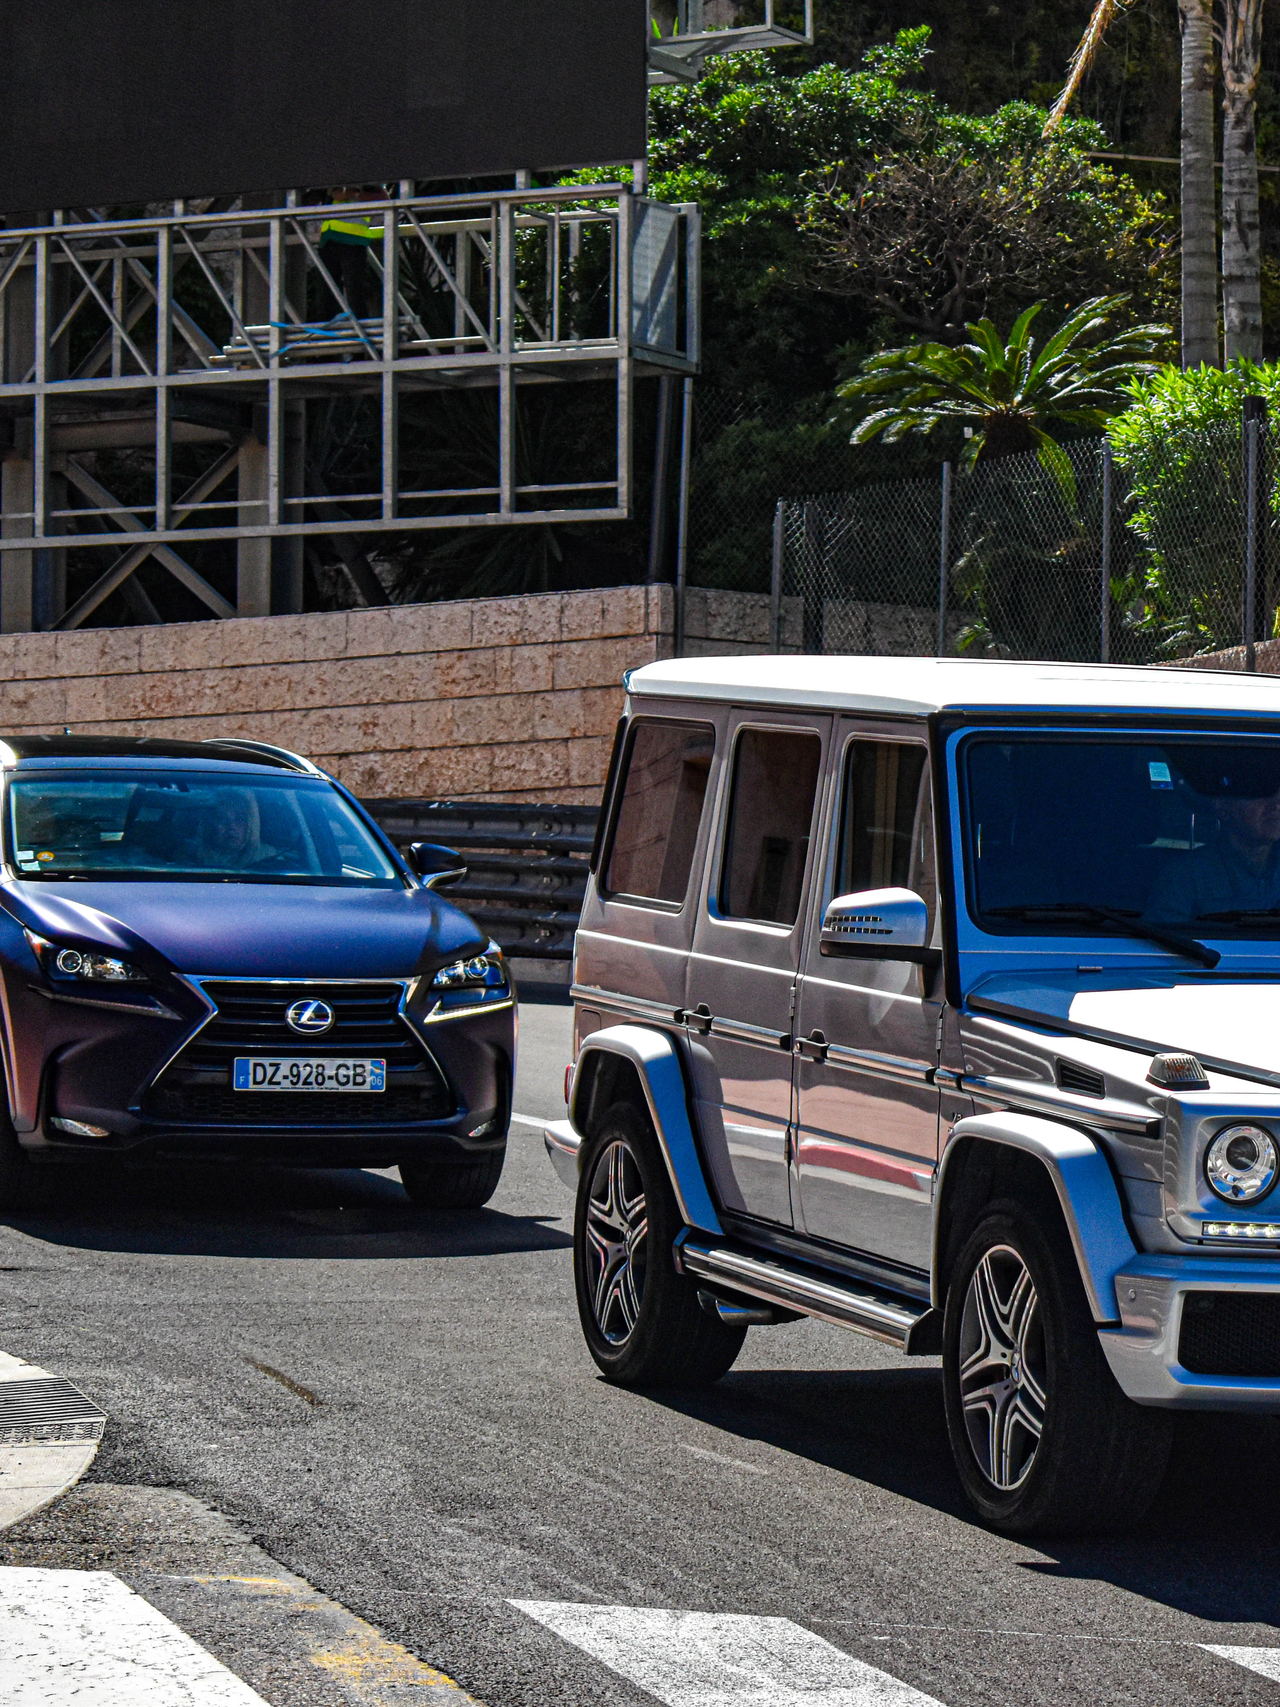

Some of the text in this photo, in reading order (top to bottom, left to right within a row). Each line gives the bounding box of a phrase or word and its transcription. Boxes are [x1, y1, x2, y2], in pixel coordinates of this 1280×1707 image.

[252, 1062, 367, 1087] DZ-928-GB
[239, 1076, 246, 1085] F
[371, 1075, 383, 1086] 06
